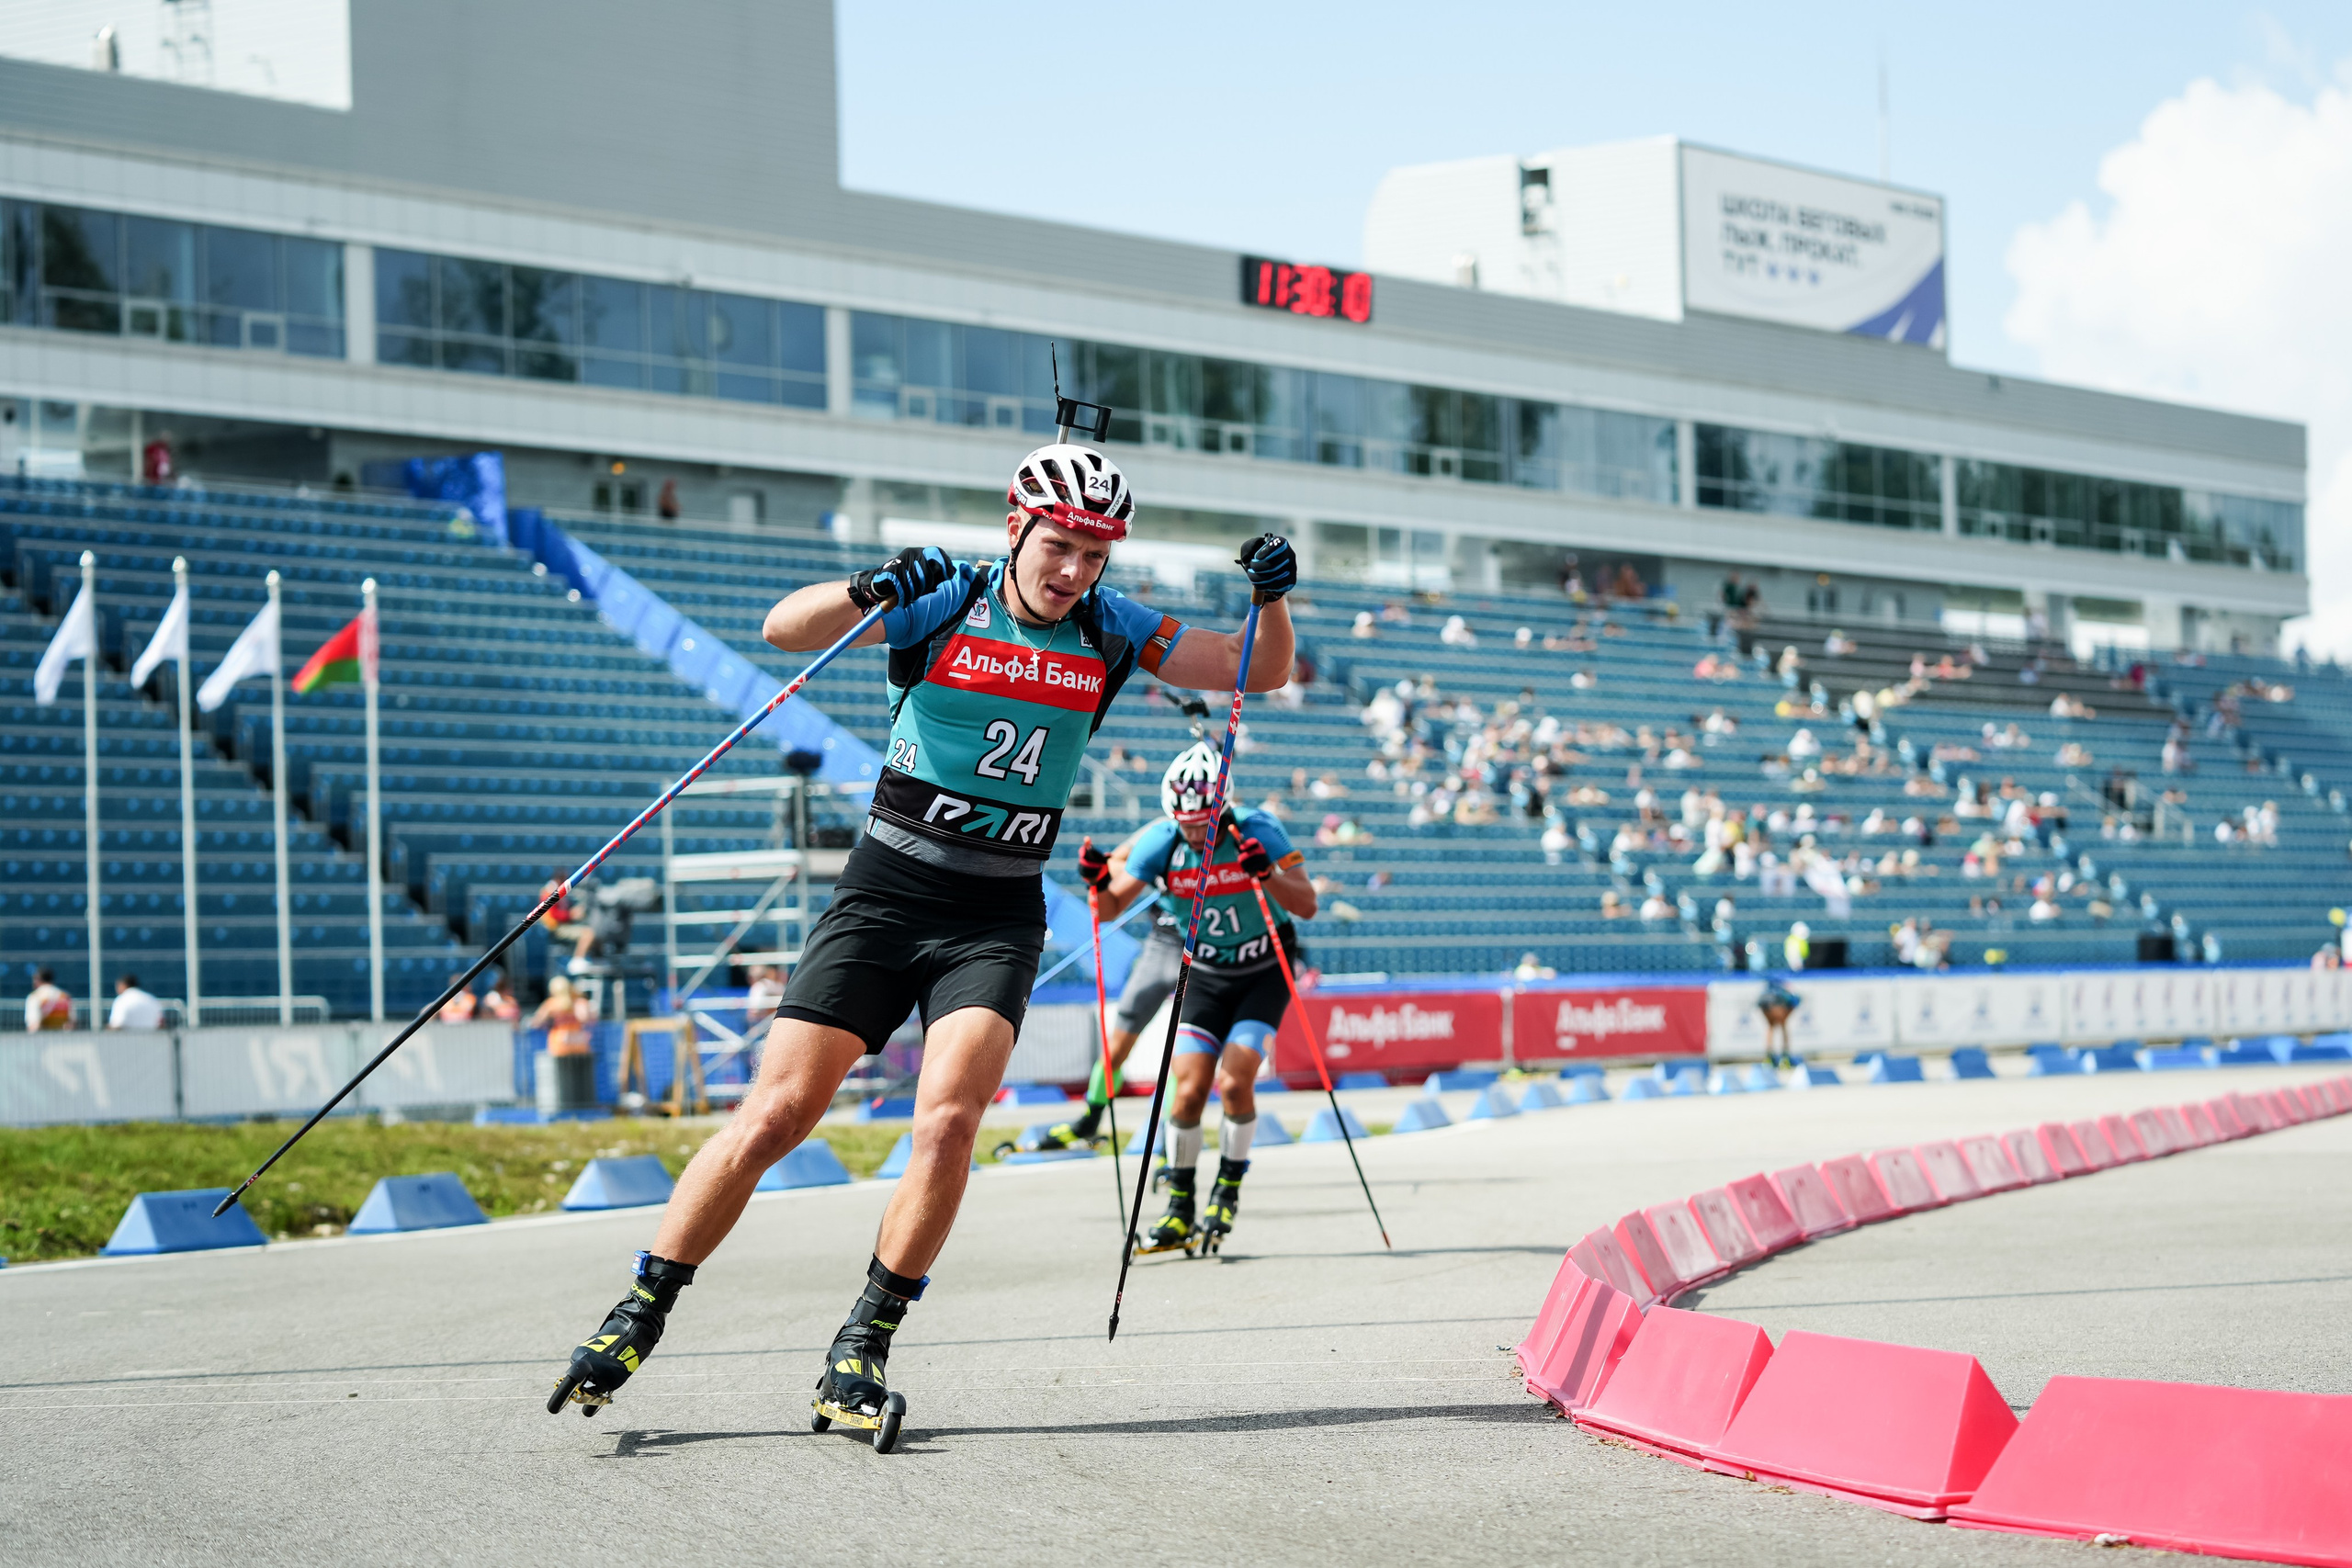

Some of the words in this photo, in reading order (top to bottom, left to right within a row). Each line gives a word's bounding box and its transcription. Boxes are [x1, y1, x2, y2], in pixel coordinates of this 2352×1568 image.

[1089, 477, 1110, 492] 24
[1068, 512, 1094, 525] Альфа
[1096, 520, 1114, 531] Банк
[952, 646, 1039, 682] Альфа
[1046, 661, 1102, 694] Банк
[890, 739, 917, 773] 24
[975, 718, 1050, 786] 24
[922, 794, 1051, 844] PARI
[1204, 906, 1241, 938] 21
